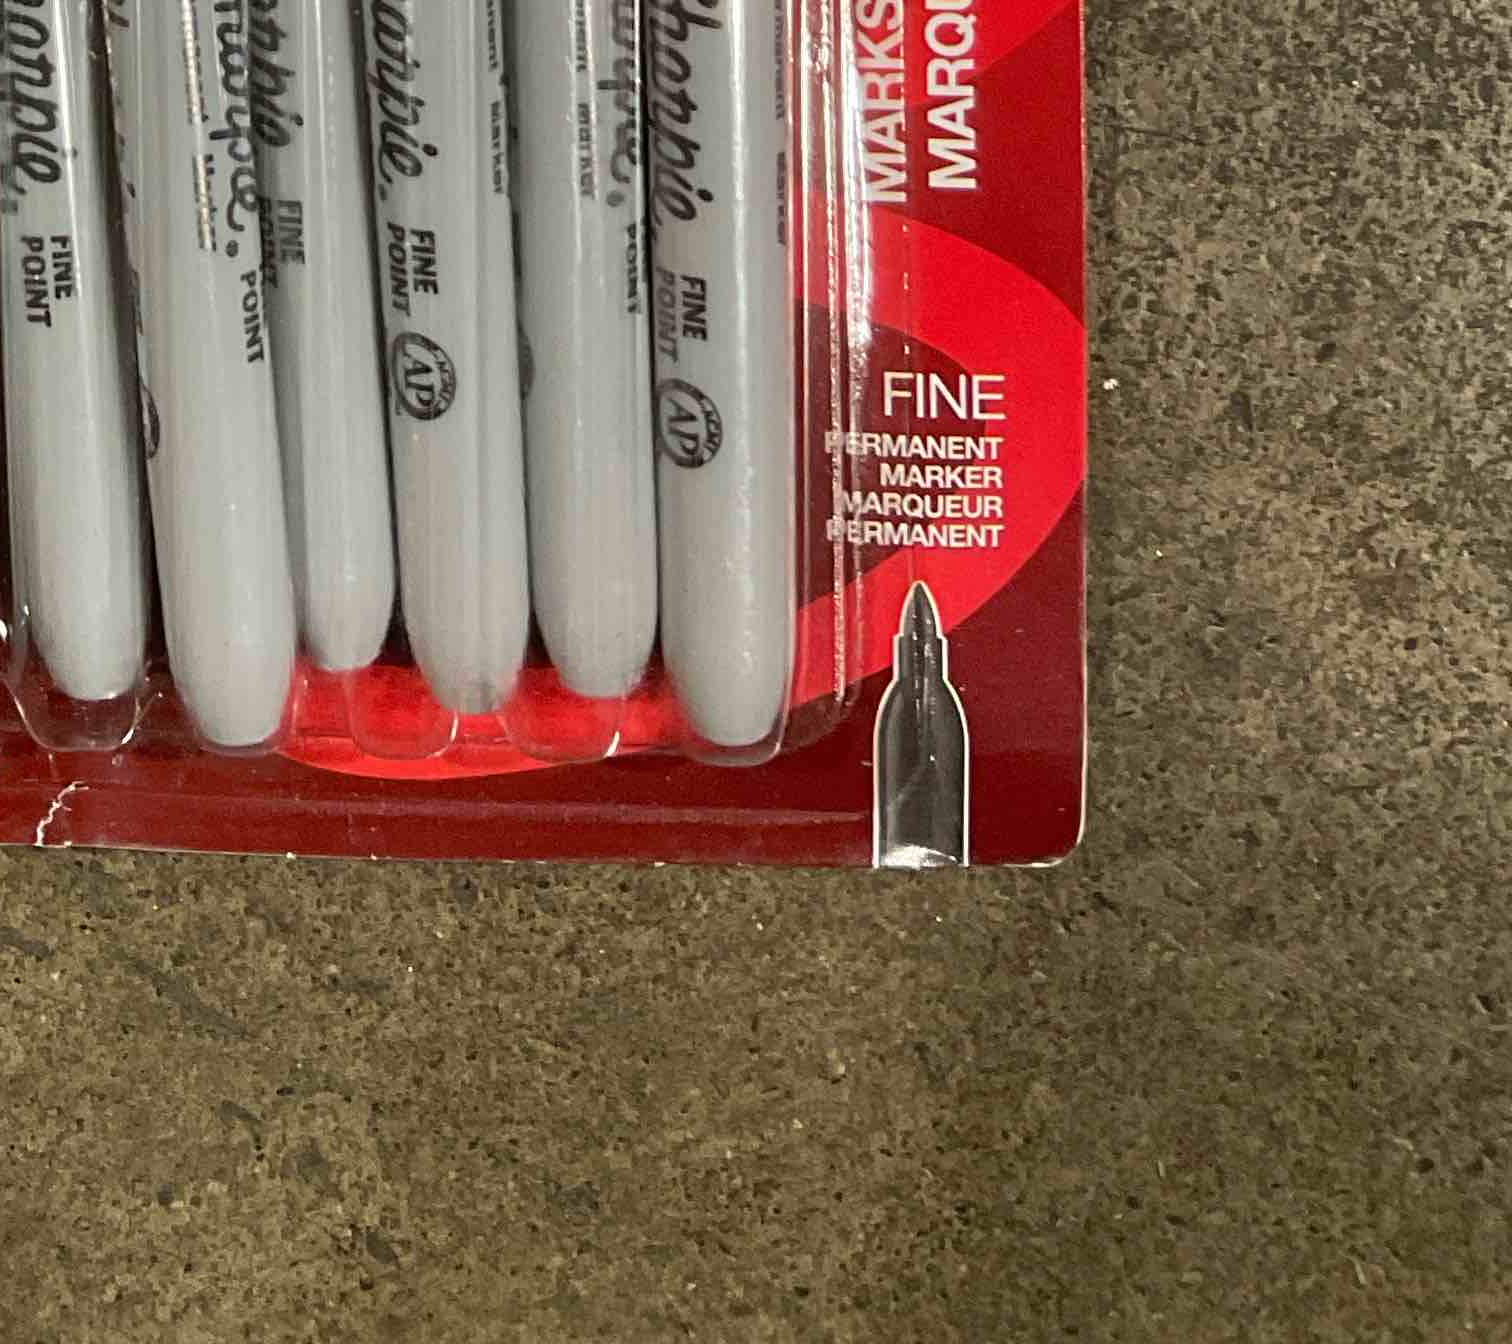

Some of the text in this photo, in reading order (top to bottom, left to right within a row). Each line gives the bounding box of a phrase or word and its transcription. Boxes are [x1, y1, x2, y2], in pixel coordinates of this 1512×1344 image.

[19, 236, 52, 327] POINT
[50, 235, 71, 301] FINE
[385, 222, 412, 318] POINT
[410, 228, 439, 295] FINE
[238, 270, 266, 365] POINT
[654, 267, 680, 363] POINT
[682, 275, 708, 342] FINE
[403, 352, 436, 408] AP
[883, 372, 1007, 421] FINE
[666, 398, 700, 455] AP
[825, 431, 1005, 461] PERMANENT
[842, 490, 1004, 519] MARQUEUR
[879, 463, 1004, 490] MARKER
[825, 518, 1005, 548] PERMANENT
